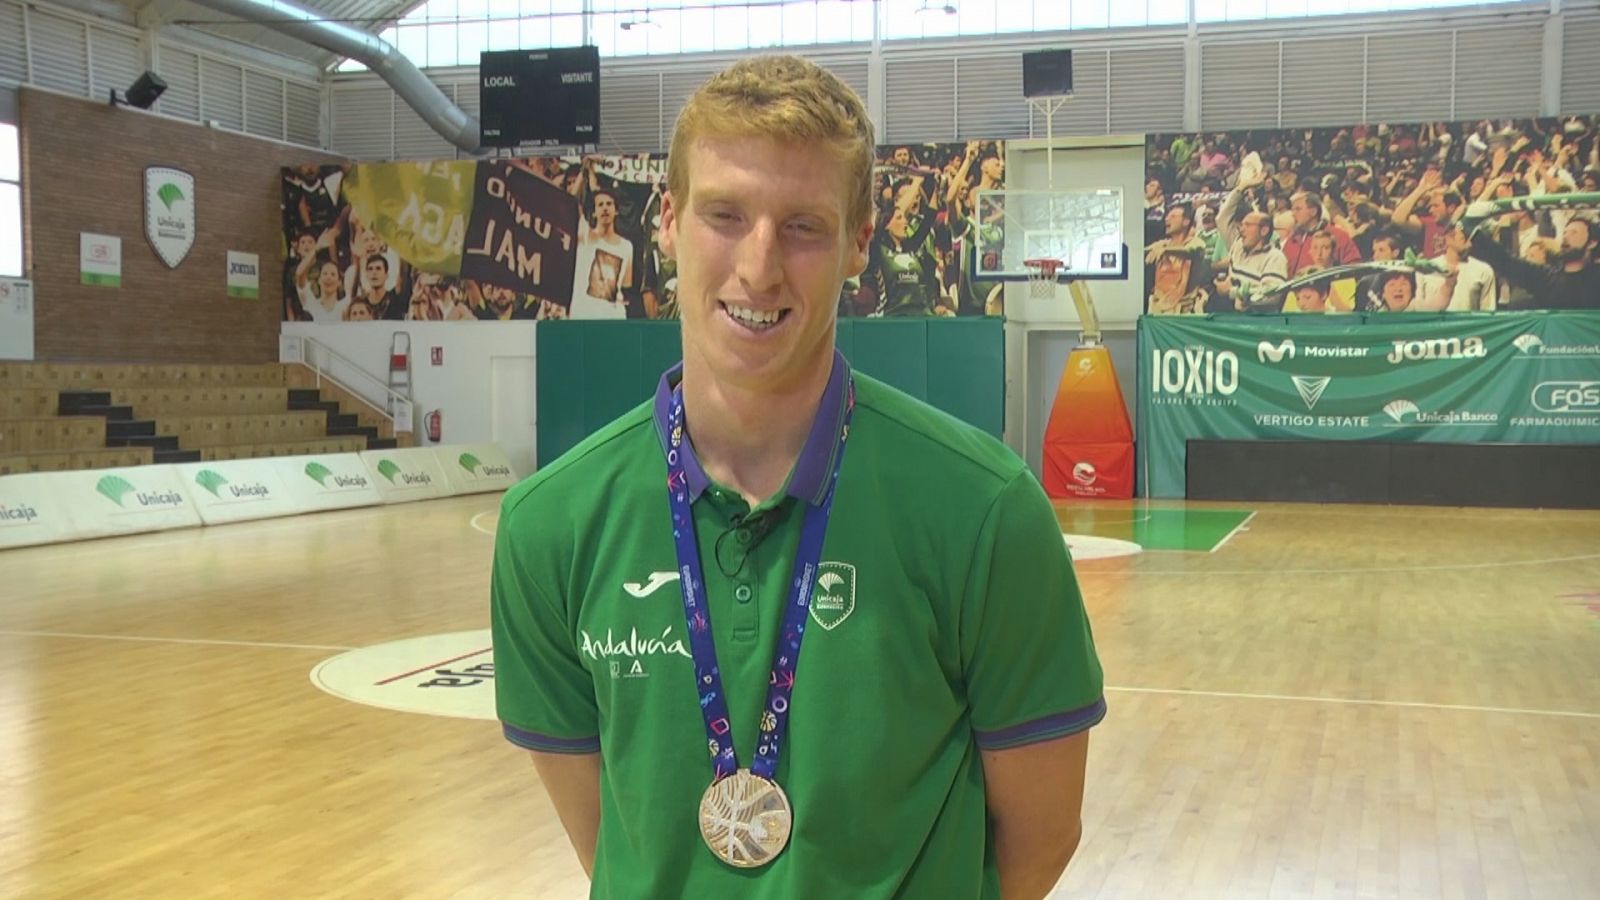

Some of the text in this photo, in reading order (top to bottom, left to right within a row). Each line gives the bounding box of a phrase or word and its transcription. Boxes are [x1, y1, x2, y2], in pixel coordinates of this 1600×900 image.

[483, 75, 516, 88] LOCAL
[560, 72, 593, 84] VISITANTE
[157, 216, 186, 231] Unicaja
[1304, 345, 1370, 357] Movistar
[1254, 414, 1370, 427] VERTIGO ESTATE
[1510, 417, 1600, 426] FARMAQUIMIC
[402, 469, 431, 485] Unicaja
[483, 462, 510, 477] Unicaja
[334, 471, 368, 488] Unicaja
[230, 483, 269, 498] Unicaja
[137, 491, 183, 506] Unicaja
[580, 625, 693, 660] Andalucía
